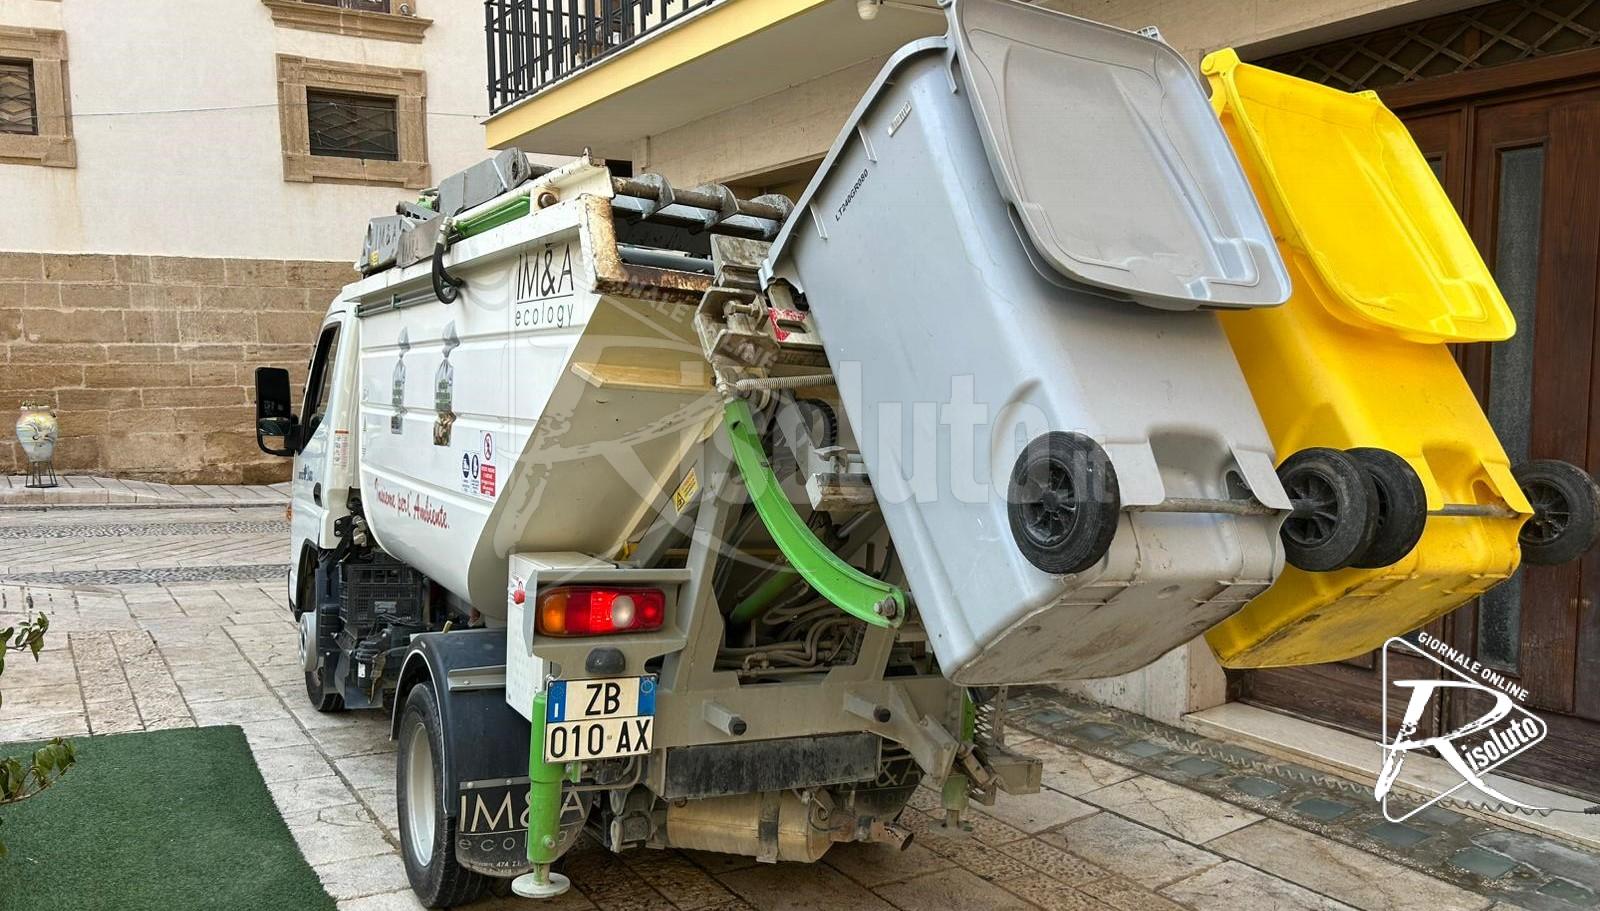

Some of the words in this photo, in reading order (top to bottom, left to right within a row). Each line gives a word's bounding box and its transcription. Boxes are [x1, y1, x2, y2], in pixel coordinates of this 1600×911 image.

[834, 168, 869, 222] LT240GR080
[516, 242, 574, 301] IM&A
[514, 301, 574, 328] ecology
[585, 682, 621, 716] ZB
[550, 723, 604, 758] 010
[616, 719, 650, 753] AX
